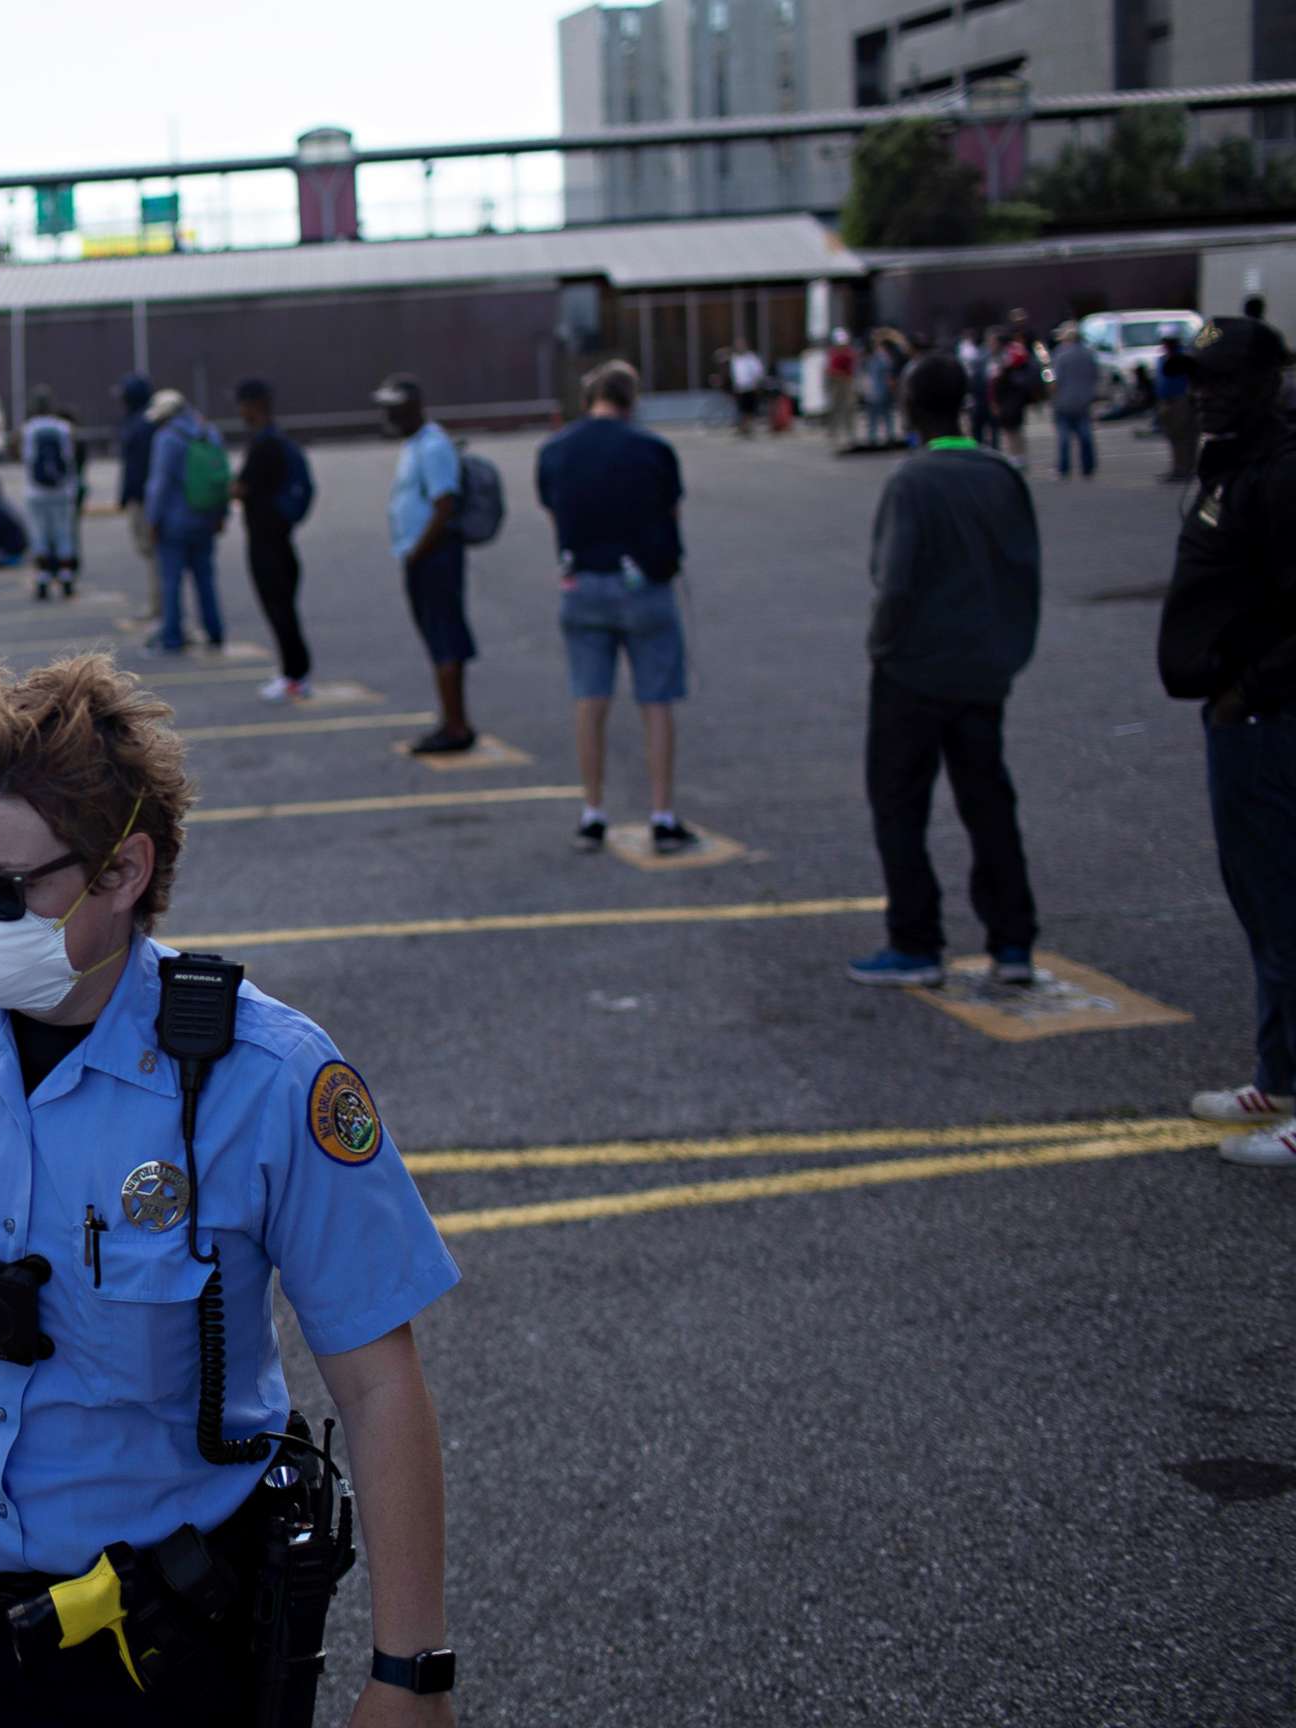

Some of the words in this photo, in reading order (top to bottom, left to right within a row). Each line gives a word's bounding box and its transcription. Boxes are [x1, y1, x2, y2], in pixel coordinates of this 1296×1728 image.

[174, 973, 223, 983] MOTOROLA
[138, 1050, 157, 1073] 8
[318, 1073, 340, 1112] ORLEANS
[319, 1116, 336, 1139] NEW
